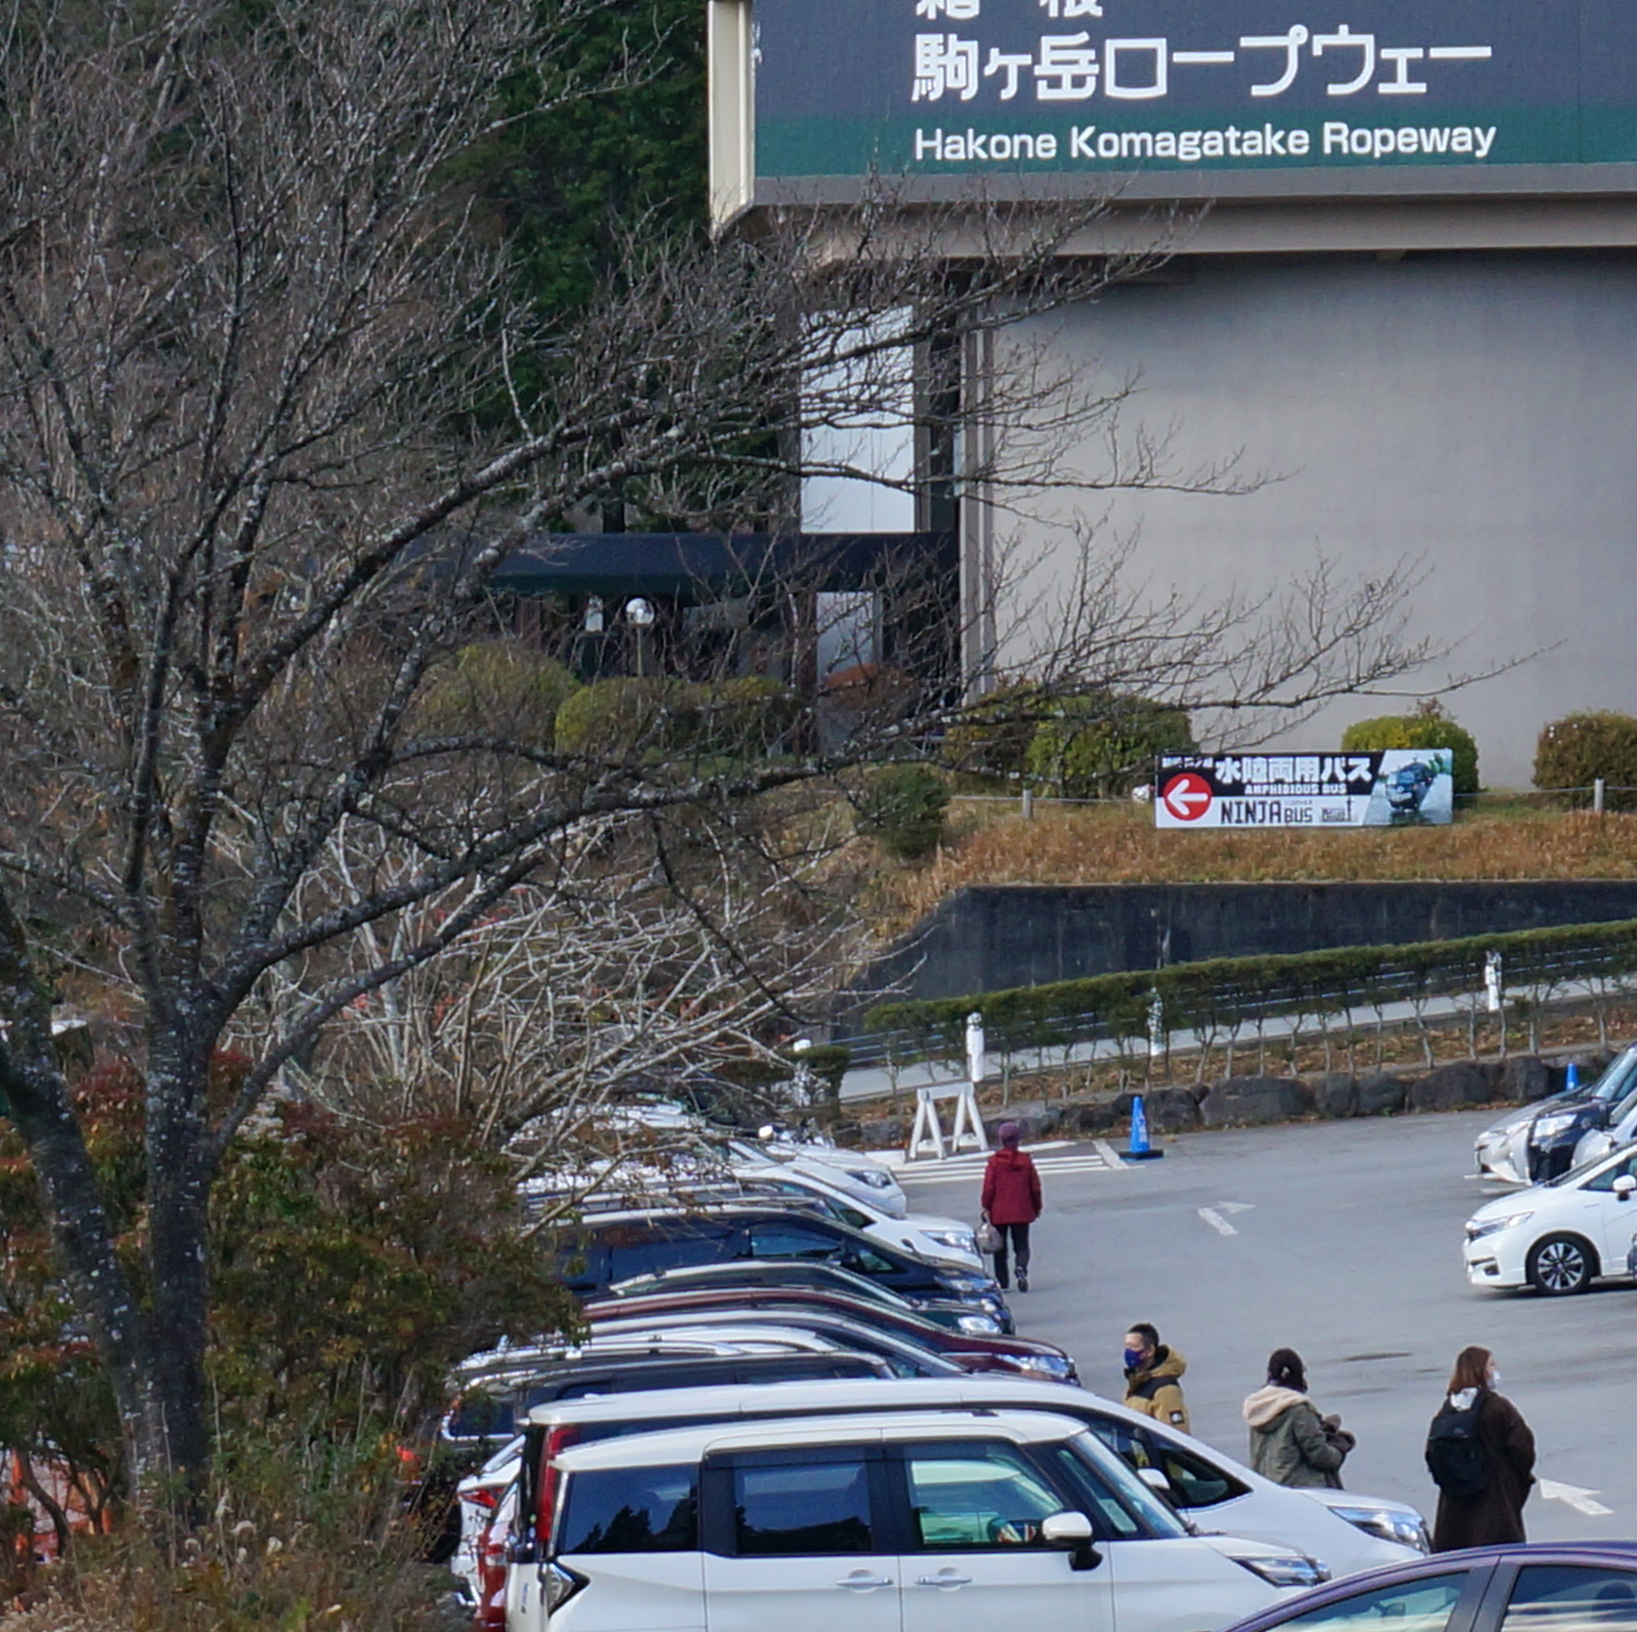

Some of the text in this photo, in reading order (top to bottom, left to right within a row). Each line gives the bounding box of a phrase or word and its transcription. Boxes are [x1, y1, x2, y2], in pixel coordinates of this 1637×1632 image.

[915, 121, 1497, 161] Hakone Komagatake Ropeway
[1215, 756, 1373, 784] 水陸両用バス
[1322, 783, 1347, 795] BUS
[1221, 800, 1282, 824] NINJA
[1284, 807, 1313, 823] BUS
